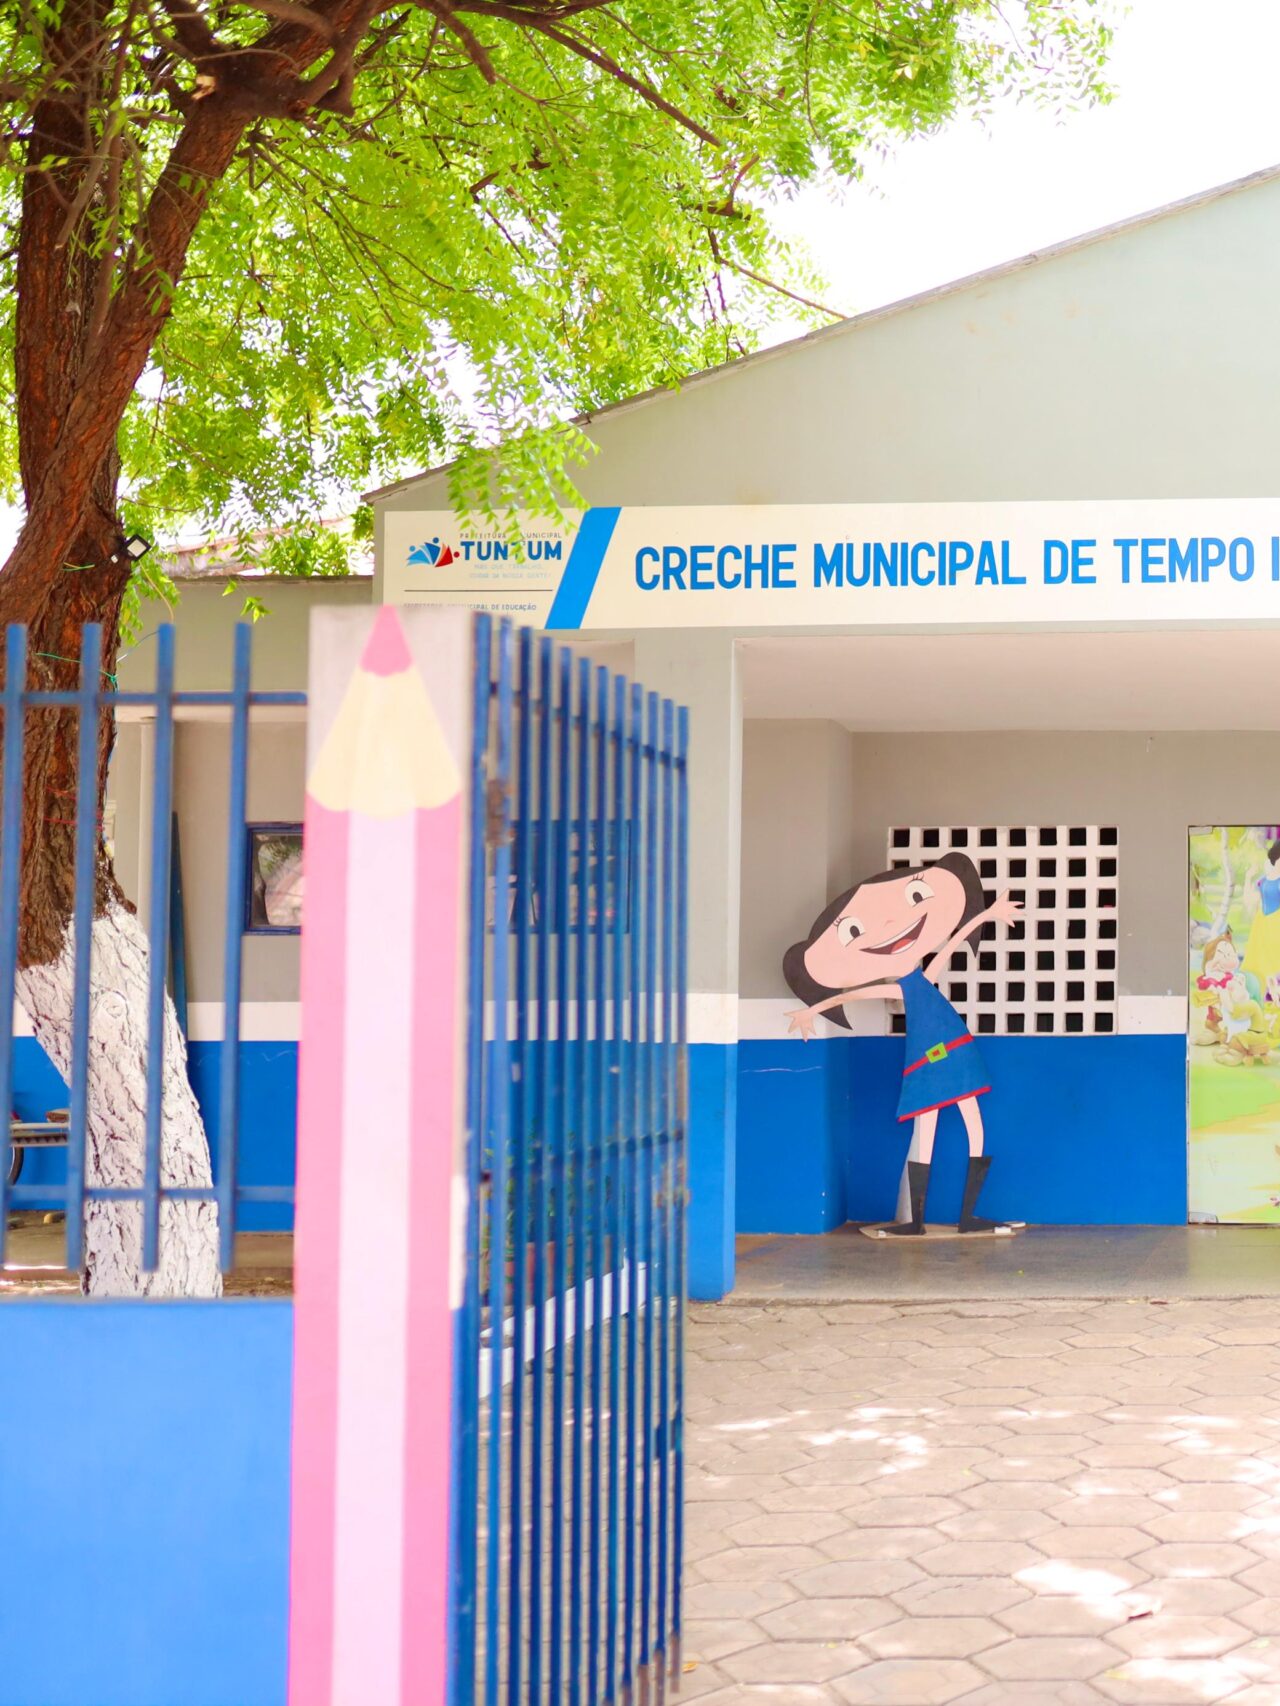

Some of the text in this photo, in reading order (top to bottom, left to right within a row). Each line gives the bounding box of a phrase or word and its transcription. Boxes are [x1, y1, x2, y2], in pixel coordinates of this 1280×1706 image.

[635, 543, 798, 591] CRECHE
[813, 539, 1028, 589] MUNICIPAL
[1043, 538, 1097, 585] DE
[1112, 536, 1255, 584] TEMPO
[501, 602, 537, 612] EDUCAÇÃO
